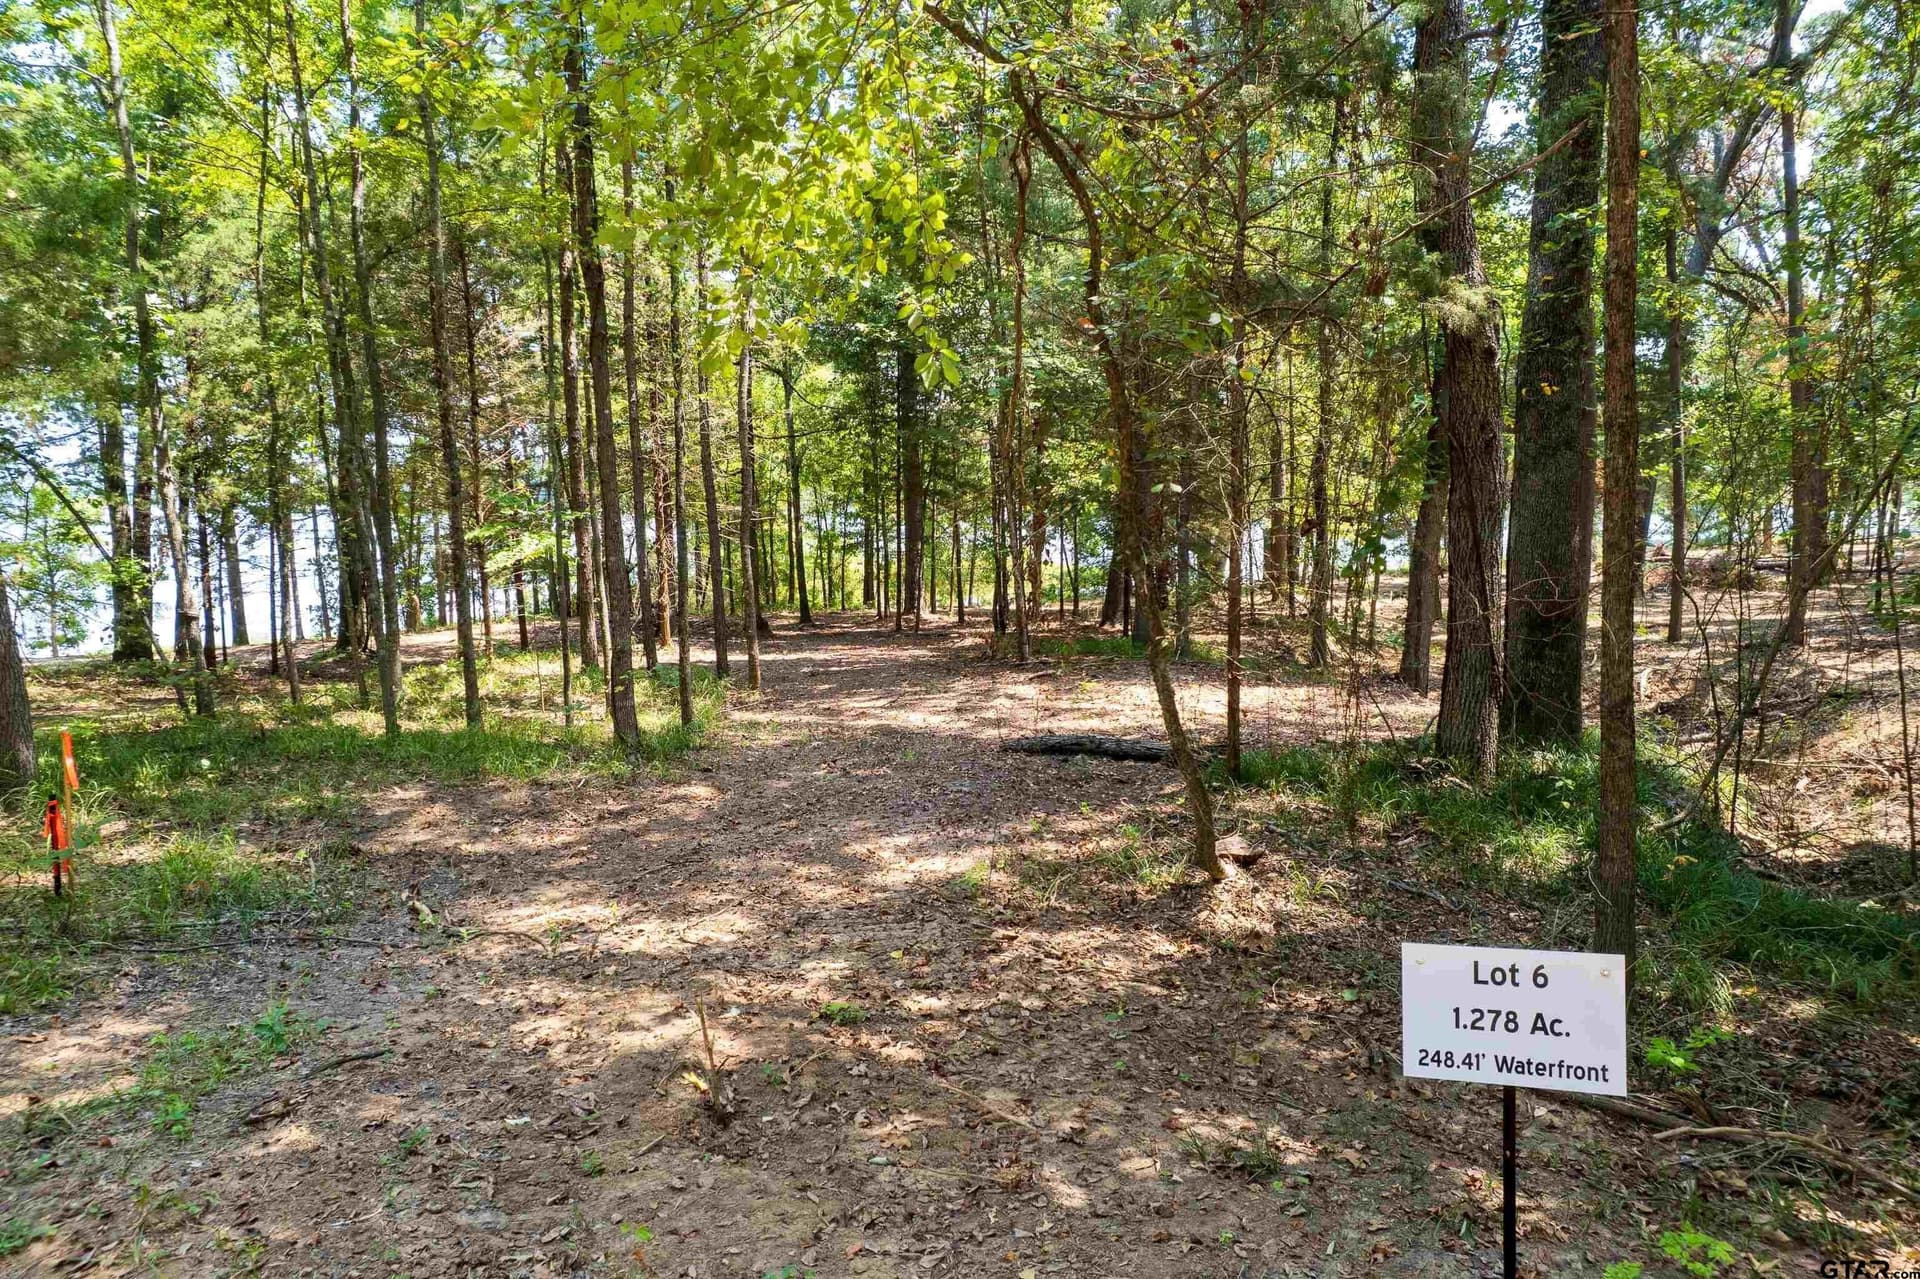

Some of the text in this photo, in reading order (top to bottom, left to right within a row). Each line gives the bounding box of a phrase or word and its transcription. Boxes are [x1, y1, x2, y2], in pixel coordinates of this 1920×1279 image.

[1473, 960, 1549, 989] Lot 6
[1452, 1006, 1571, 1038] 1.278 Ac.
[1418, 1048, 1609, 1083] 248.41' Waterfront
